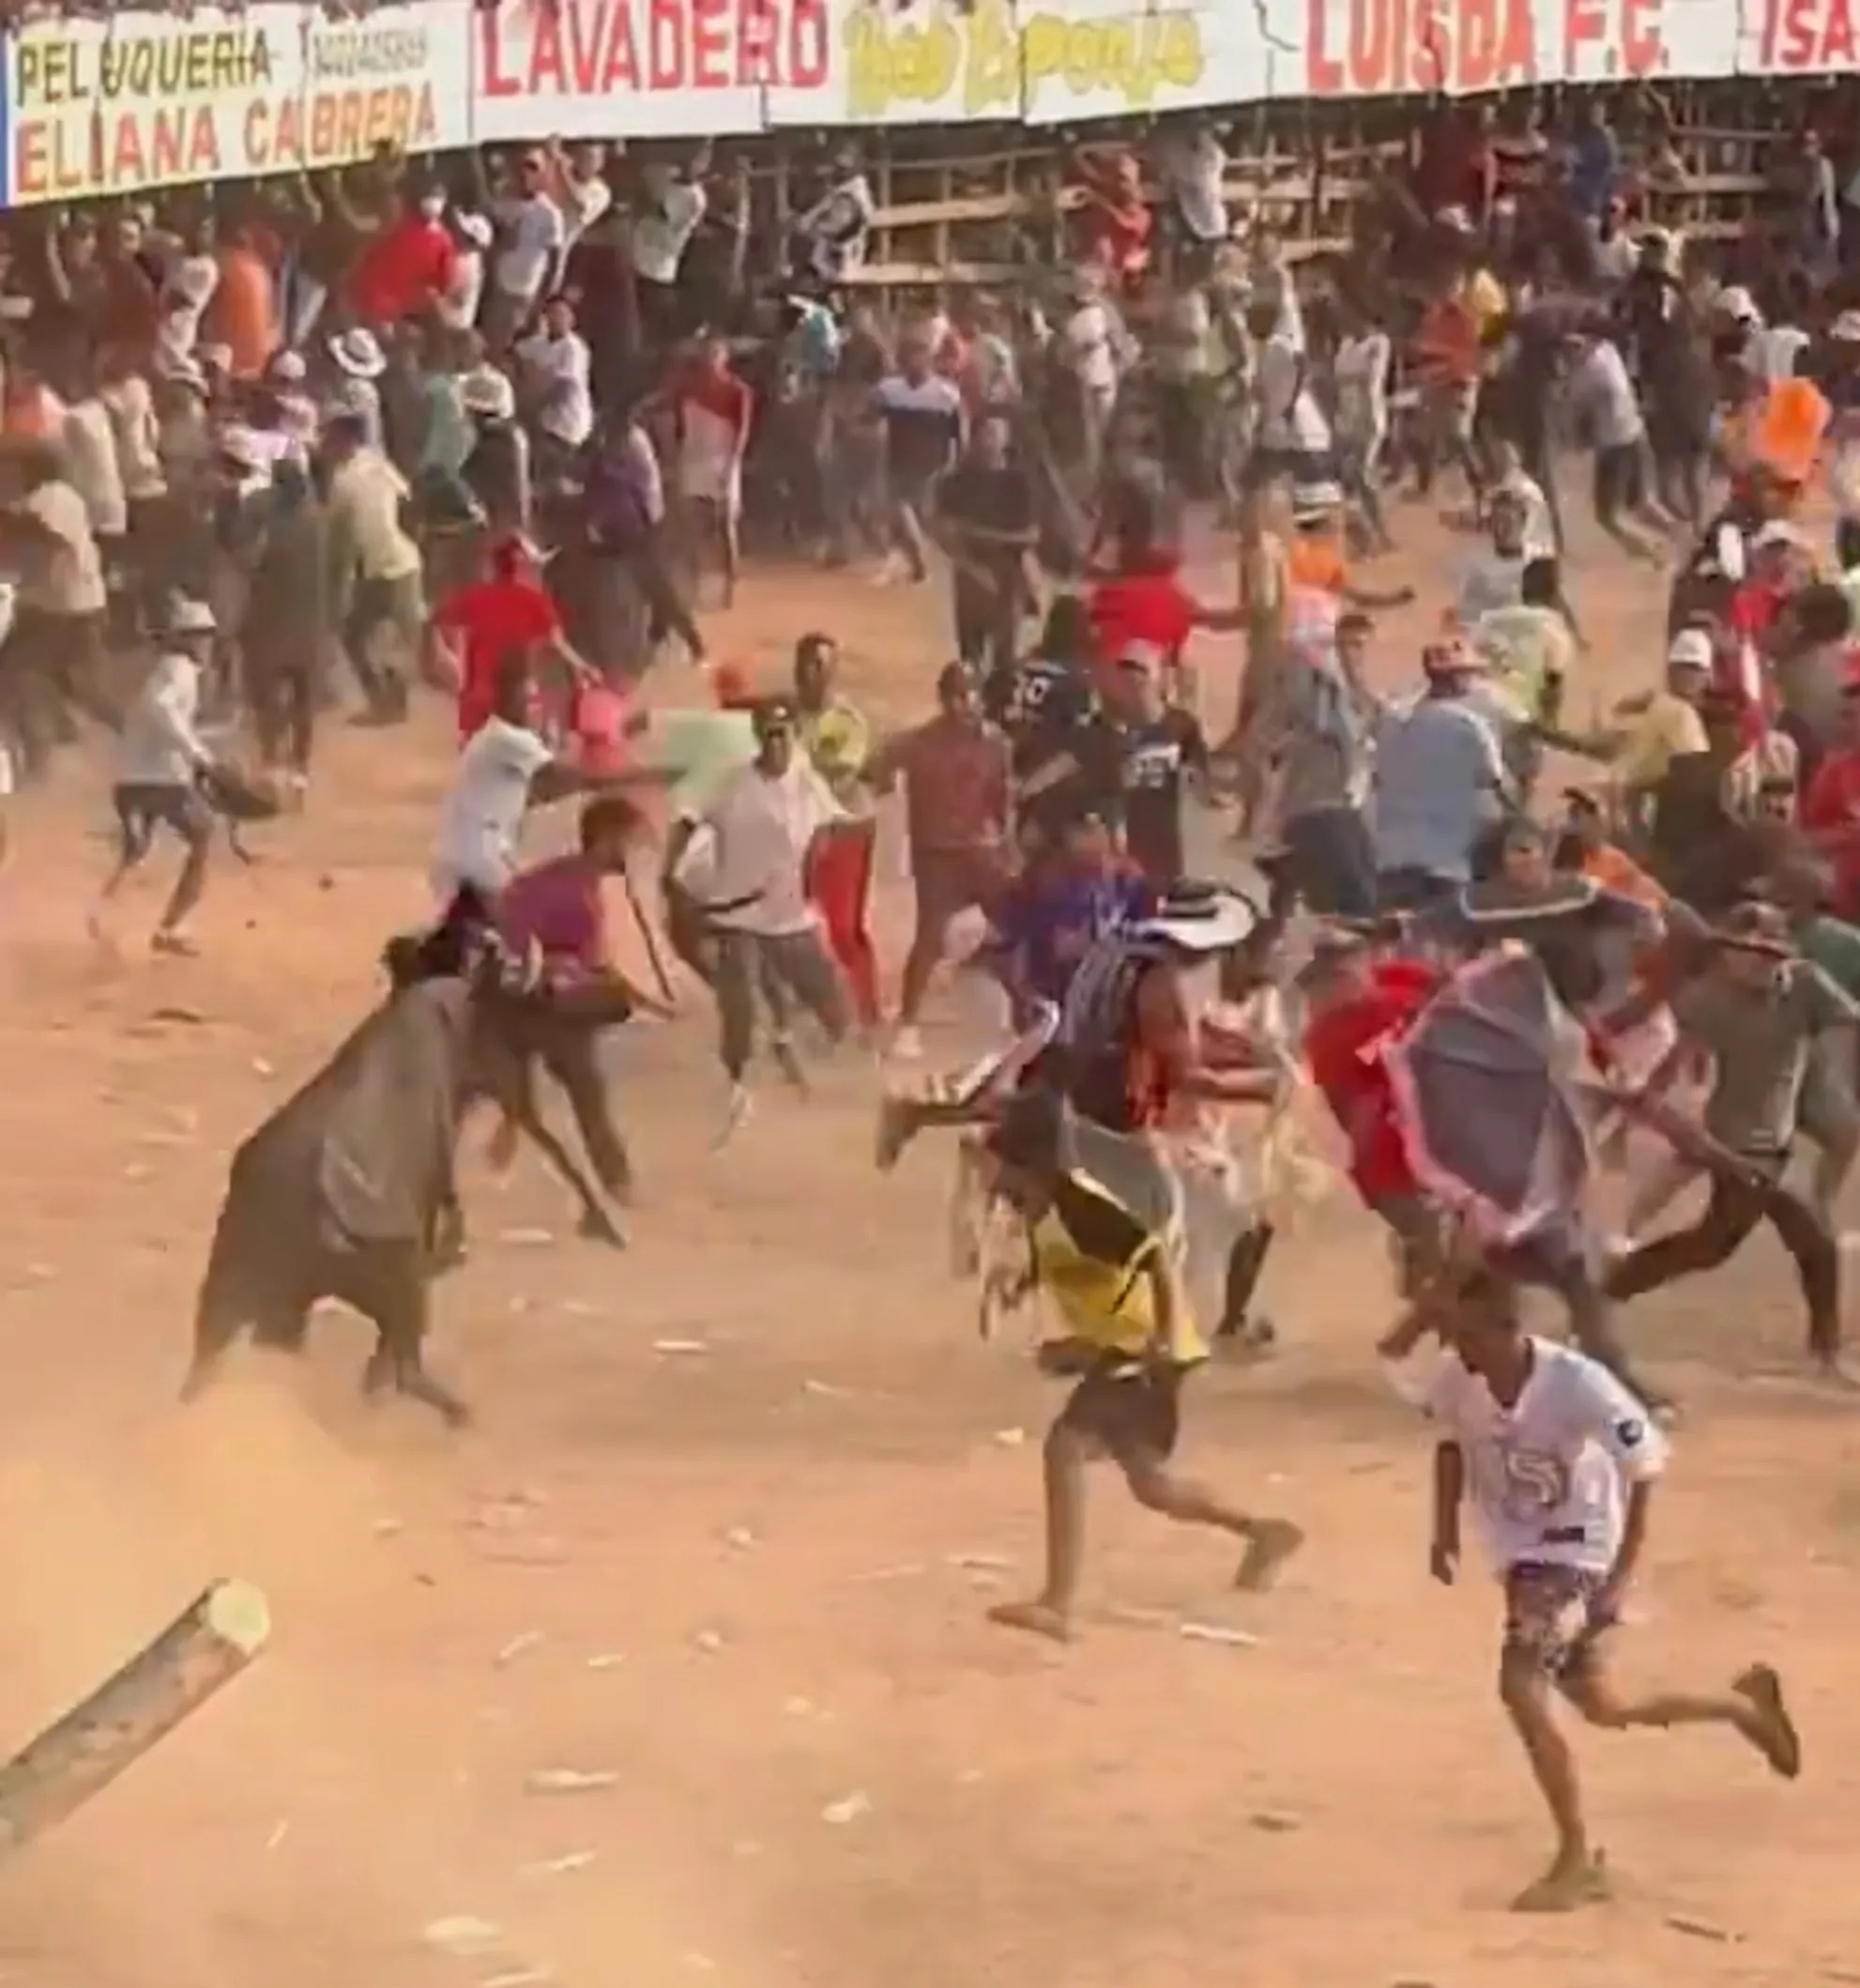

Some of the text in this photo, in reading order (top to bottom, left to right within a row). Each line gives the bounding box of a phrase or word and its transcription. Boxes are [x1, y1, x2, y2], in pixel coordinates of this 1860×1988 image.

[480, 0, 829, 96] LAVADERO
[1306, 0, 1538, 91] LUISDA
[16, 79, 438, 192] ELIANA CABRERA
